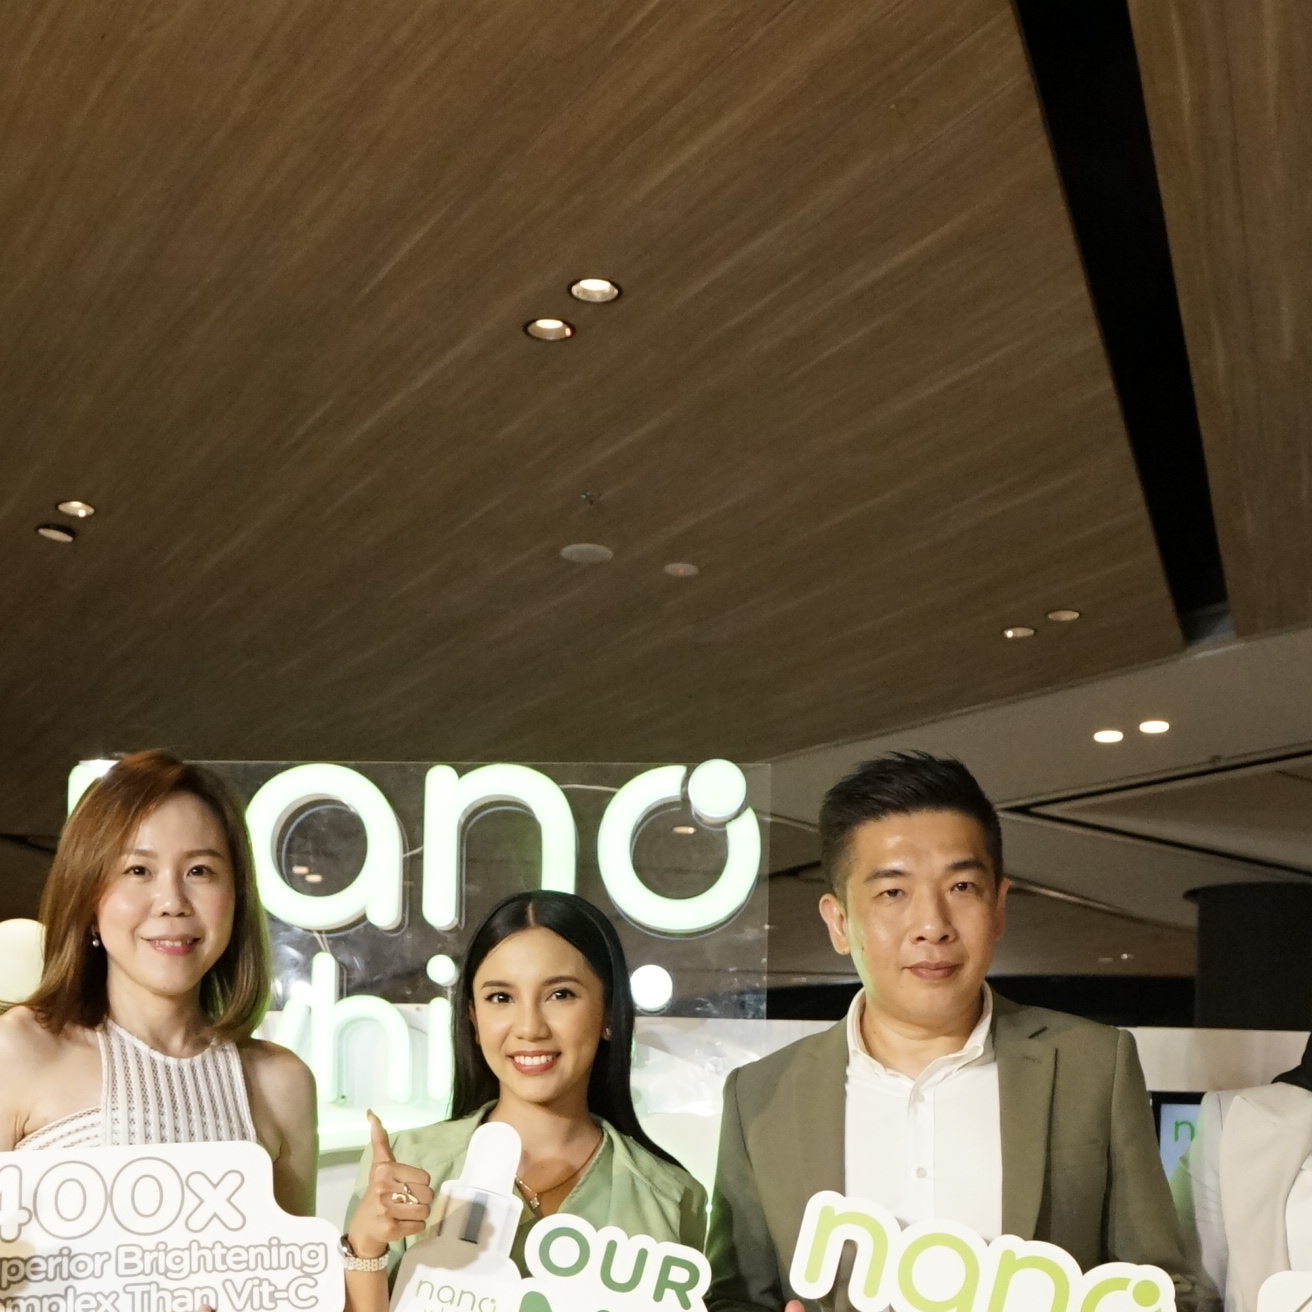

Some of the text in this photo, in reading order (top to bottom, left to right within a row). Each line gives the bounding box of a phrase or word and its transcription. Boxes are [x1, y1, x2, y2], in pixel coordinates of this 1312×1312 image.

[67, 758, 762, 934] ano
[116, 1237, 327, 1279] Brightening
[539, 1227, 700, 1311] OUR
[224, 1273, 320, 1312] Vit-C
